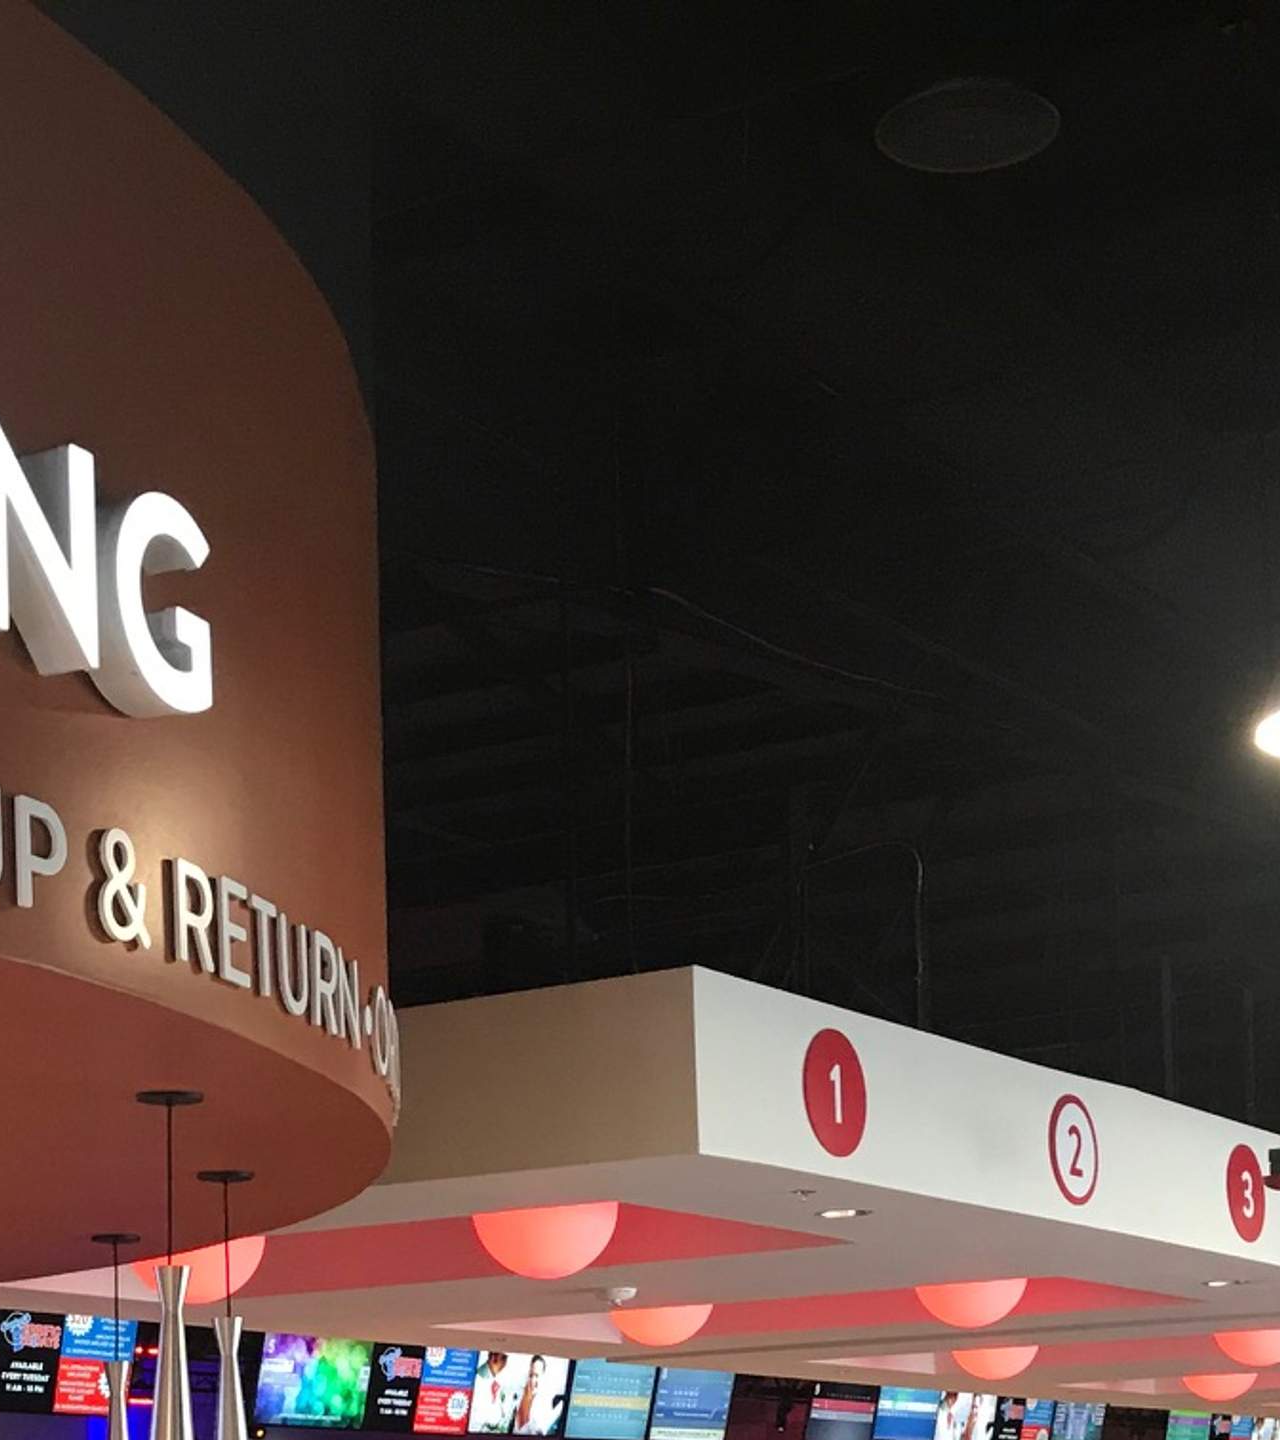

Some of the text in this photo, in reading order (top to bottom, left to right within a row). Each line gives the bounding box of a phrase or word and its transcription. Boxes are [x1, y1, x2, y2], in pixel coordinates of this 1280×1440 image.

[96, 826, 152, 950] &
[172, 856, 362, 1050] RETURN
[828, 1063, 844, 1125] 1
[1067, 1124, 1084, 1178] 2
[1240, 1170, 1255, 1219] 3
